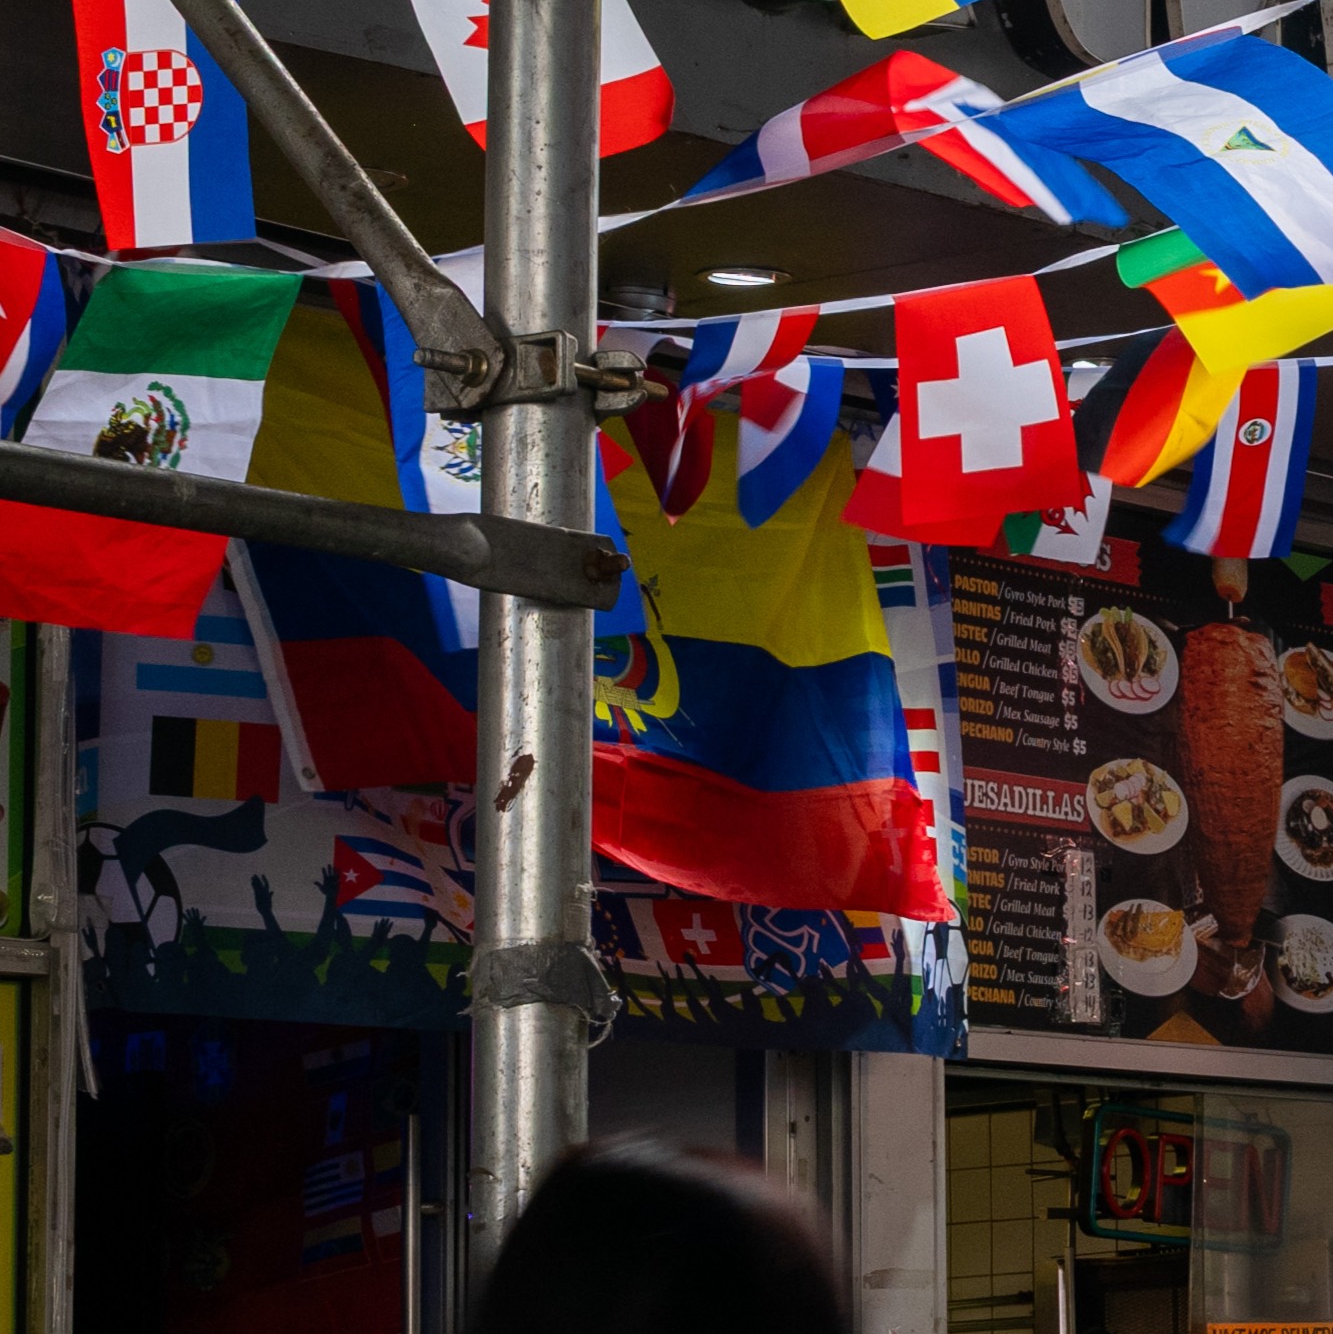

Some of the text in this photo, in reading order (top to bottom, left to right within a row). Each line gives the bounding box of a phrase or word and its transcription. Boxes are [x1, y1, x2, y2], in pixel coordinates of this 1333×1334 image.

[961, 722, 1014, 743] PECHANO
[963, 778, 1085, 824] UESADILLAS
[1102, 1128, 1284, 1237] OPEN
